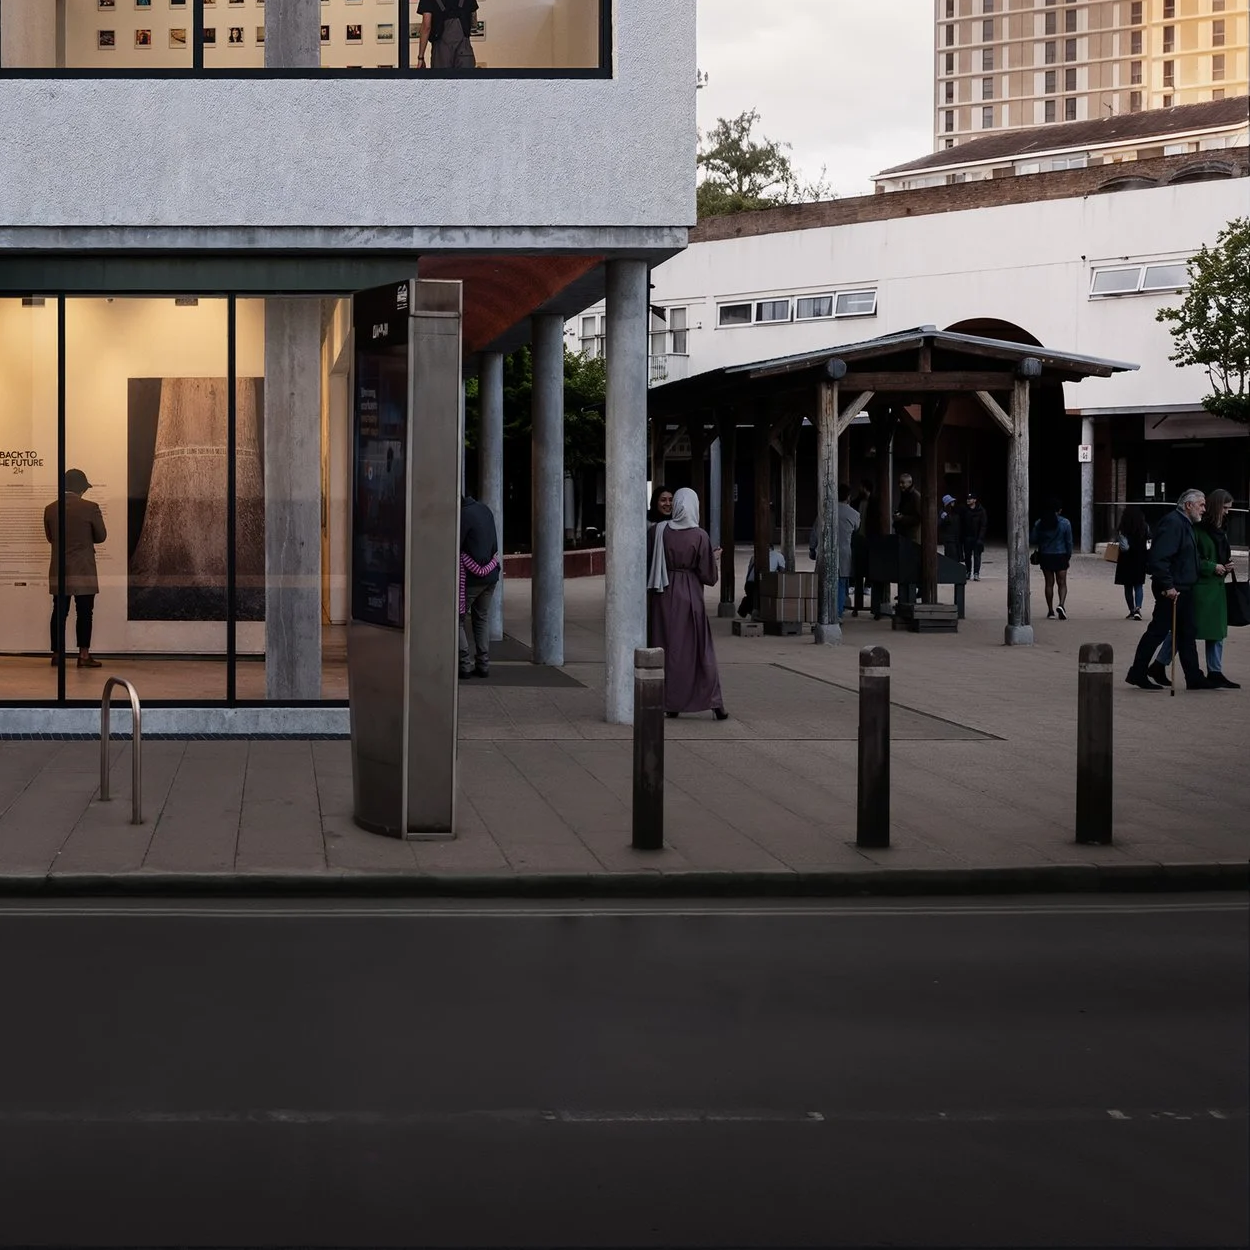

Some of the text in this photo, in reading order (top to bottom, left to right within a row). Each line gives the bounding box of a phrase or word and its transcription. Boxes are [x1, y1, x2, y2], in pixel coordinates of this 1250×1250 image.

[0, 451, 38, 459] BACK TO
[11, 459, 44, 467] FUTURE
